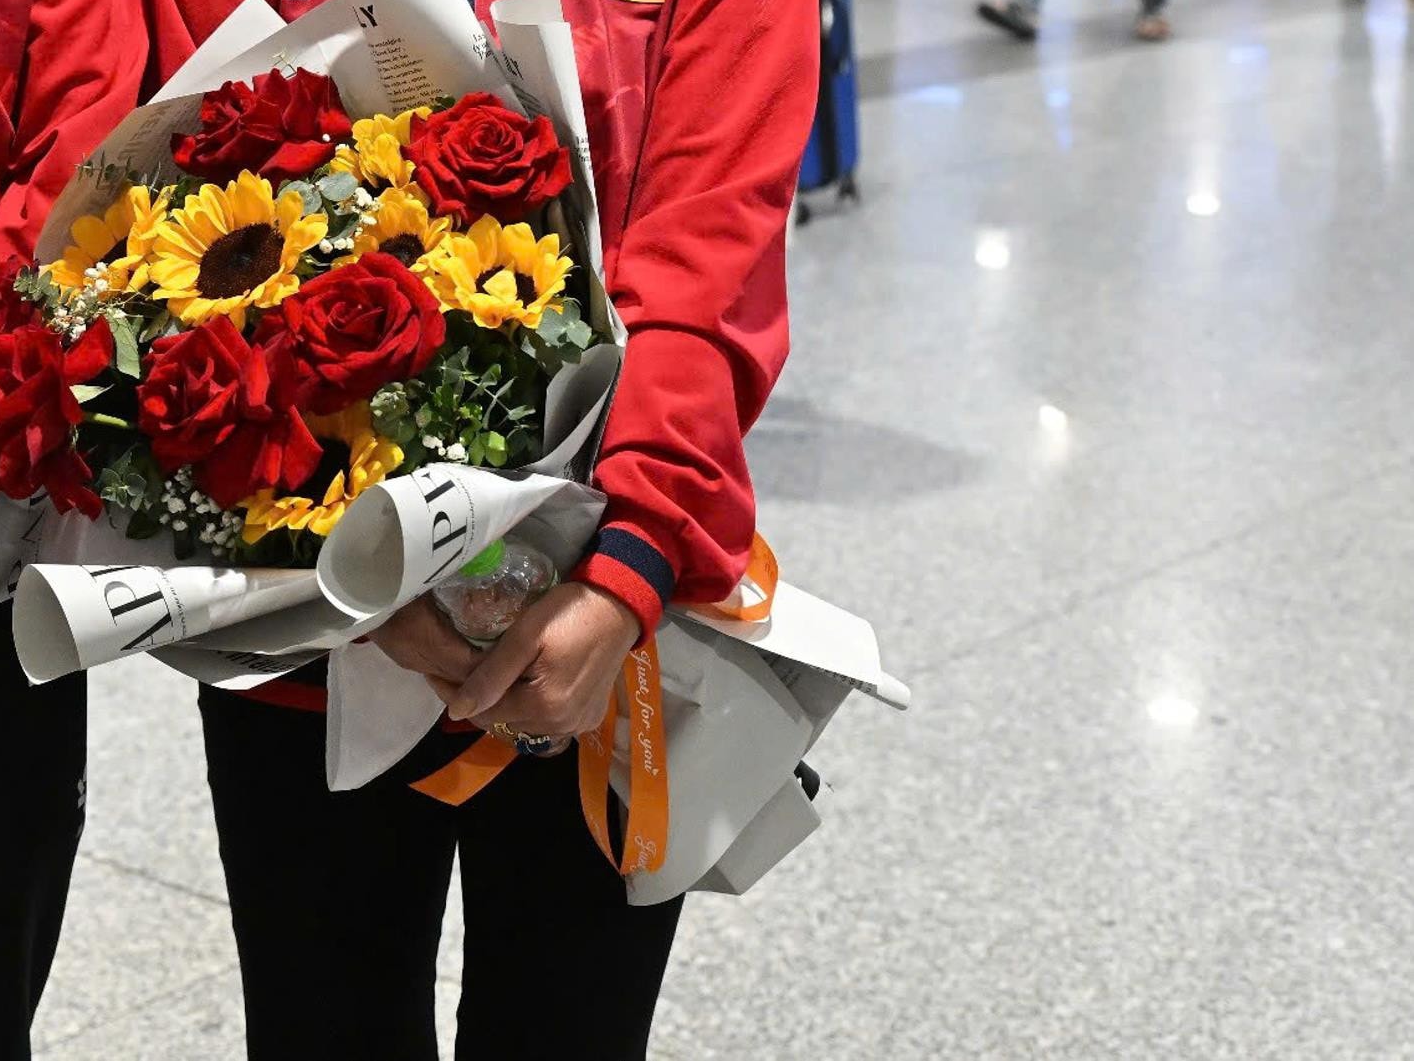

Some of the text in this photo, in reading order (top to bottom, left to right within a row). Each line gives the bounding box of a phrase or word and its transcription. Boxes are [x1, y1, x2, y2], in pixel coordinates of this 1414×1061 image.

[629, 649, 654, 774] Just for you
